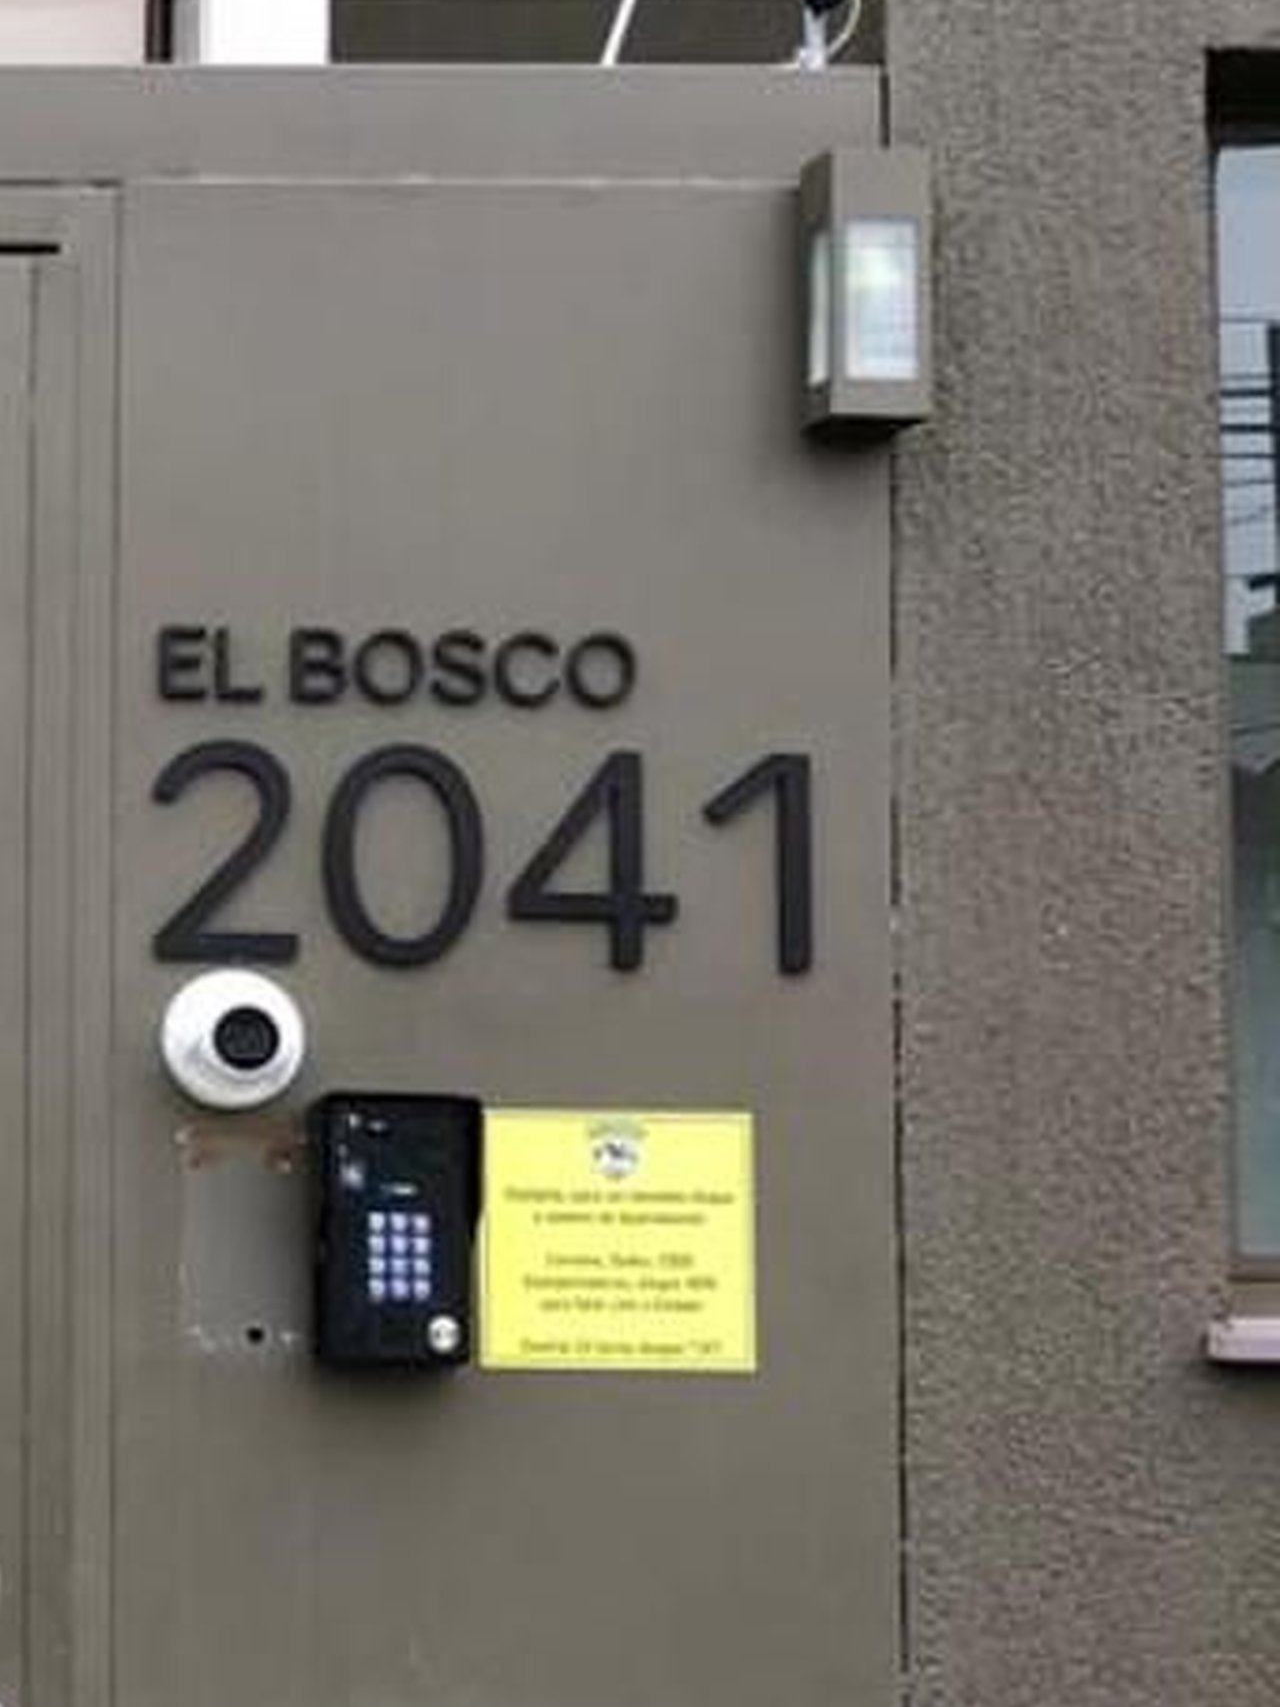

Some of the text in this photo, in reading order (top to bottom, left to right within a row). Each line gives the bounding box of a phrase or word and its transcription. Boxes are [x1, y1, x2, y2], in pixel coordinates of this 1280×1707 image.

[156, 626, 638, 710] EL BOSCO
[151, 739, 813, 978] 2041
